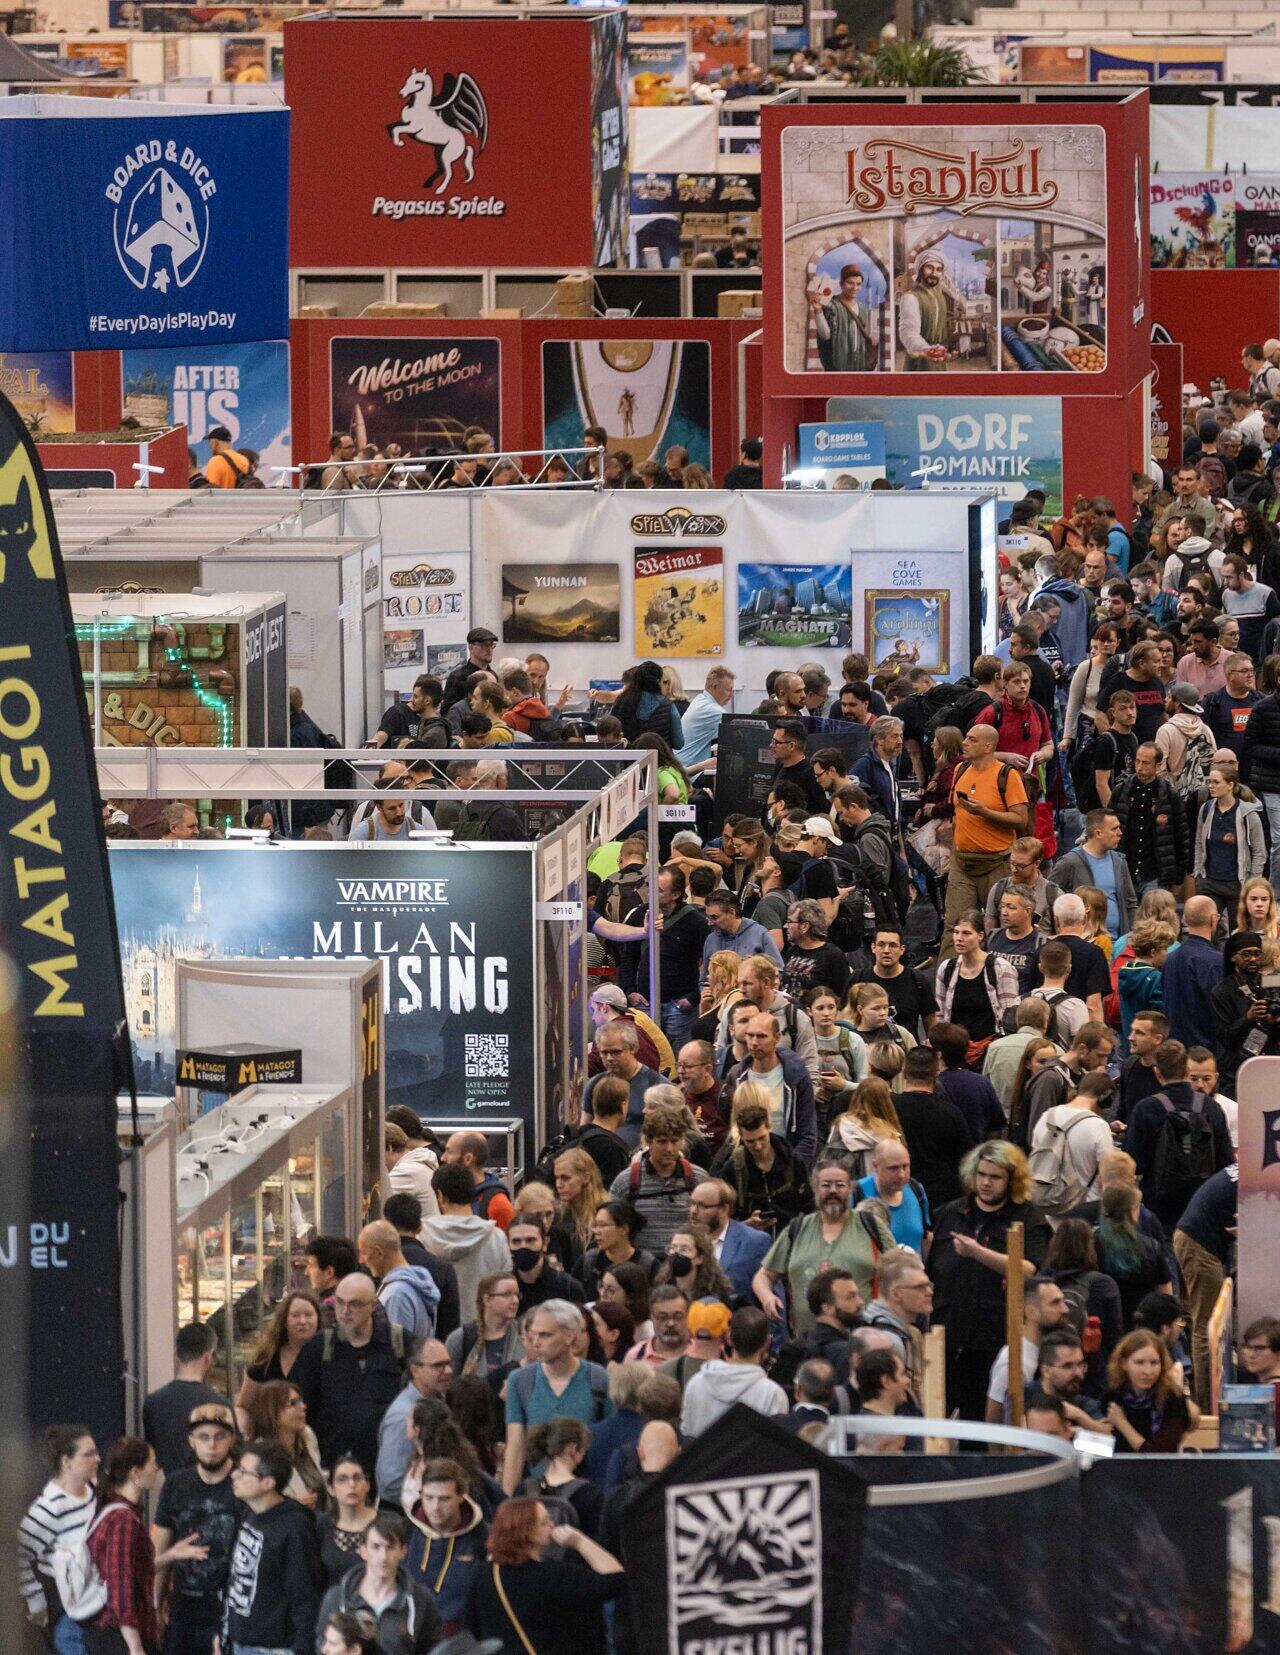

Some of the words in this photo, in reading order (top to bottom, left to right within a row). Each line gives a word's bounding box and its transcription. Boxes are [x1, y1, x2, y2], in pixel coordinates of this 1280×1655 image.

[105, 139, 162, 204] BOARD
[165, 140, 178, 163] &
[179, 147, 217, 201] DICE
[845, 137, 1059, 216] Istanbul
[371, 197, 445, 219] Pegasus
[449, 196, 506, 219] Spiele
[89, 310, 236, 335] #EveryDayIsPlayDay
[174, 365, 240, 390] AFTER
[348, 347, 461, 395] Welcome
[384, 387, 404, 404] TO
[406, 375, 435, 398] THE
[437, 362, 483, 390] MOON
[173, 390, 241, 446] US
[917, 413, 1034, 451] DORF
[919, 455, 1032, 477] ROMANTIK
[636, 552, 702, 576] Weimar
[892, 569, 922, 579] COVE
[534, 576, 587, 588] YUNNAN
[892, 579, 922, 587] GAMES
[383, 592, 463, 618] ROOT
[759, 620, 836, 633] MAGNATE
[104, 692, 125, 721] &
[129, 702, 185, 748] DIC
[338, 882, 447, 901] VAMPIRE
[313, 921, 476, 955] MILAN
[196, 1062, 226, 1073] MATAGOT
[257, 1060, 295, 1072] MATAGOT
[30, 1222, 70, 1245] DU
[31, 1246, 68, 1269] EL
